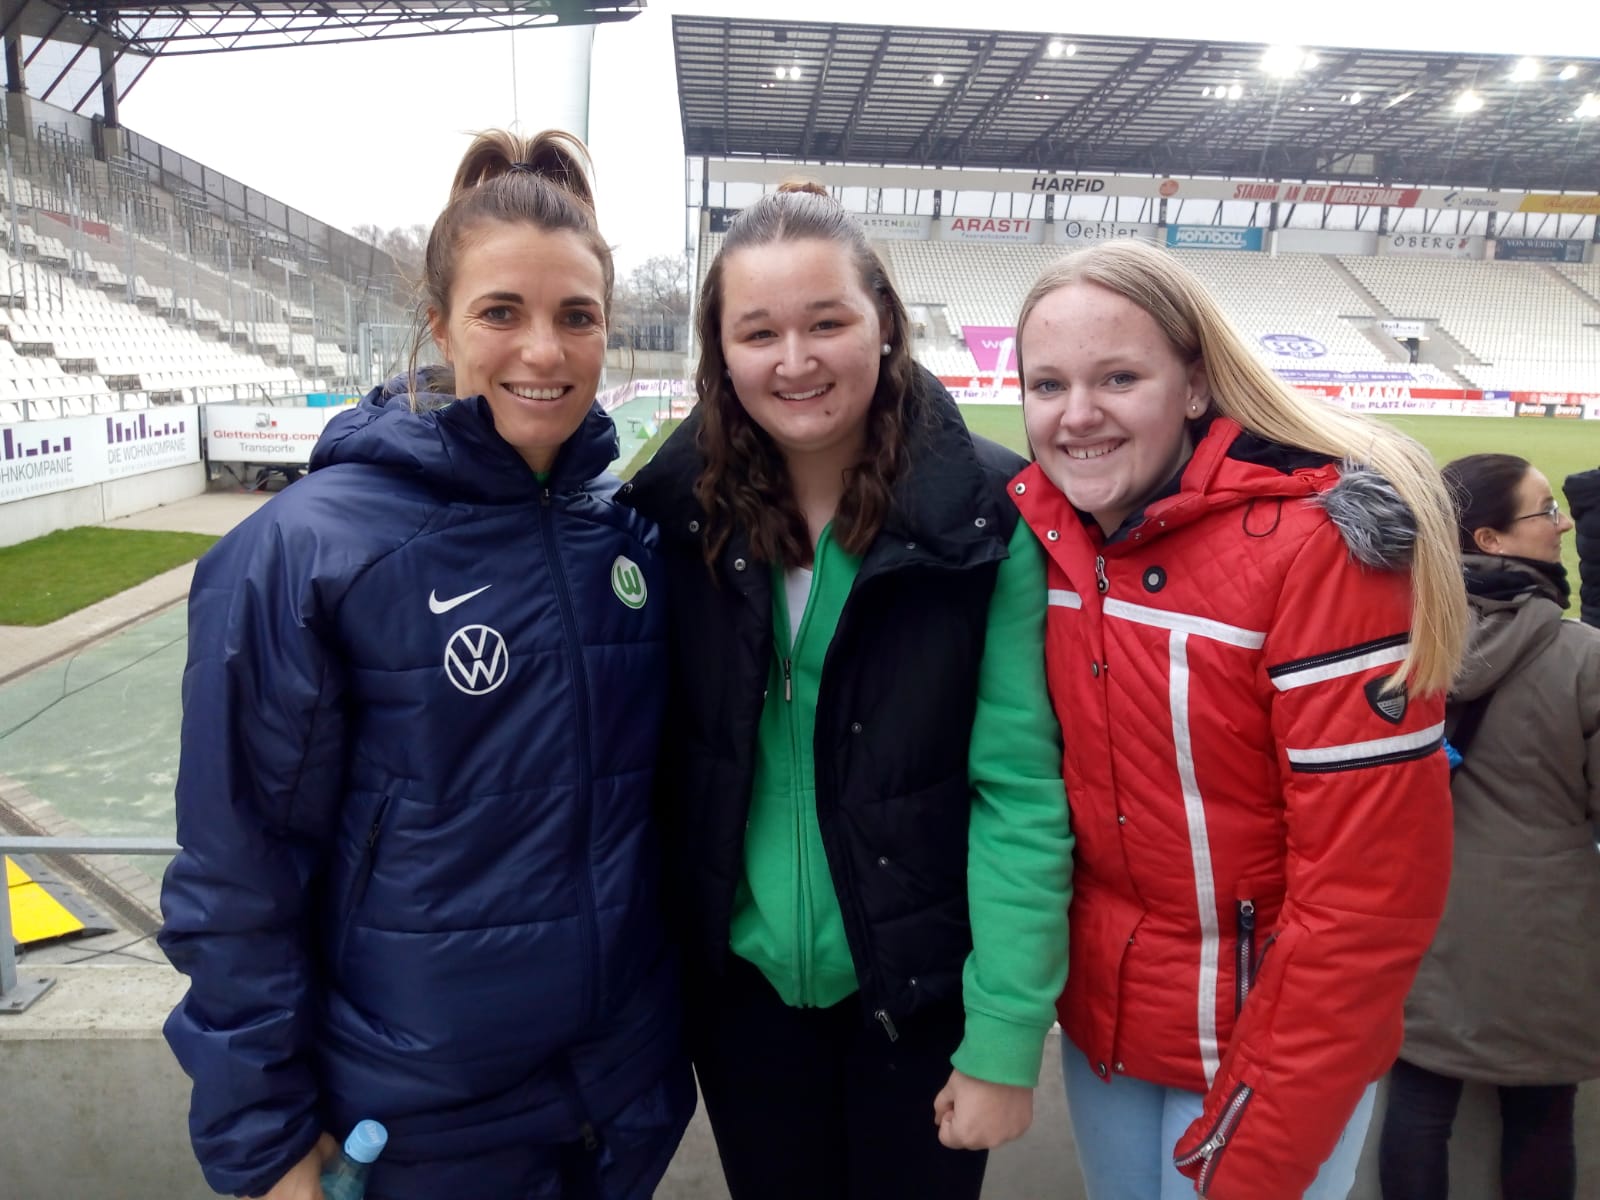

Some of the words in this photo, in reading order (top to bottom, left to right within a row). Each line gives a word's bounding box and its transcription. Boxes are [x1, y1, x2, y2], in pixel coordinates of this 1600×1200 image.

[1032, 177, 1105, 193] HARFID
[1233, 184, 1279, 199] STADION
[1284, 185, 1301, 200] AN
[1304, 186, 1326, 201] DER
[951, 218, 1032, 233] ARASTI
[1065, 221, 1138, 238] Oehler
[1507, 239, 1526, 248] VON
[1527, 239, 1565, 249] WERDEN
[1340, 386, 1411, 399] AMANA
[1368, 401, 1399, 409] PLATZ
[1402, 400, 1417, 408] für
[213, 430, 320, 442] Glettenberg.com
[107, 448, 122, 464] DIE
[123, 438, 187, 461] WOHNKOMPANIE
[240, 442, 296, 454] Transporte
[0, 456, 73, 483] HNKOMPANIE
